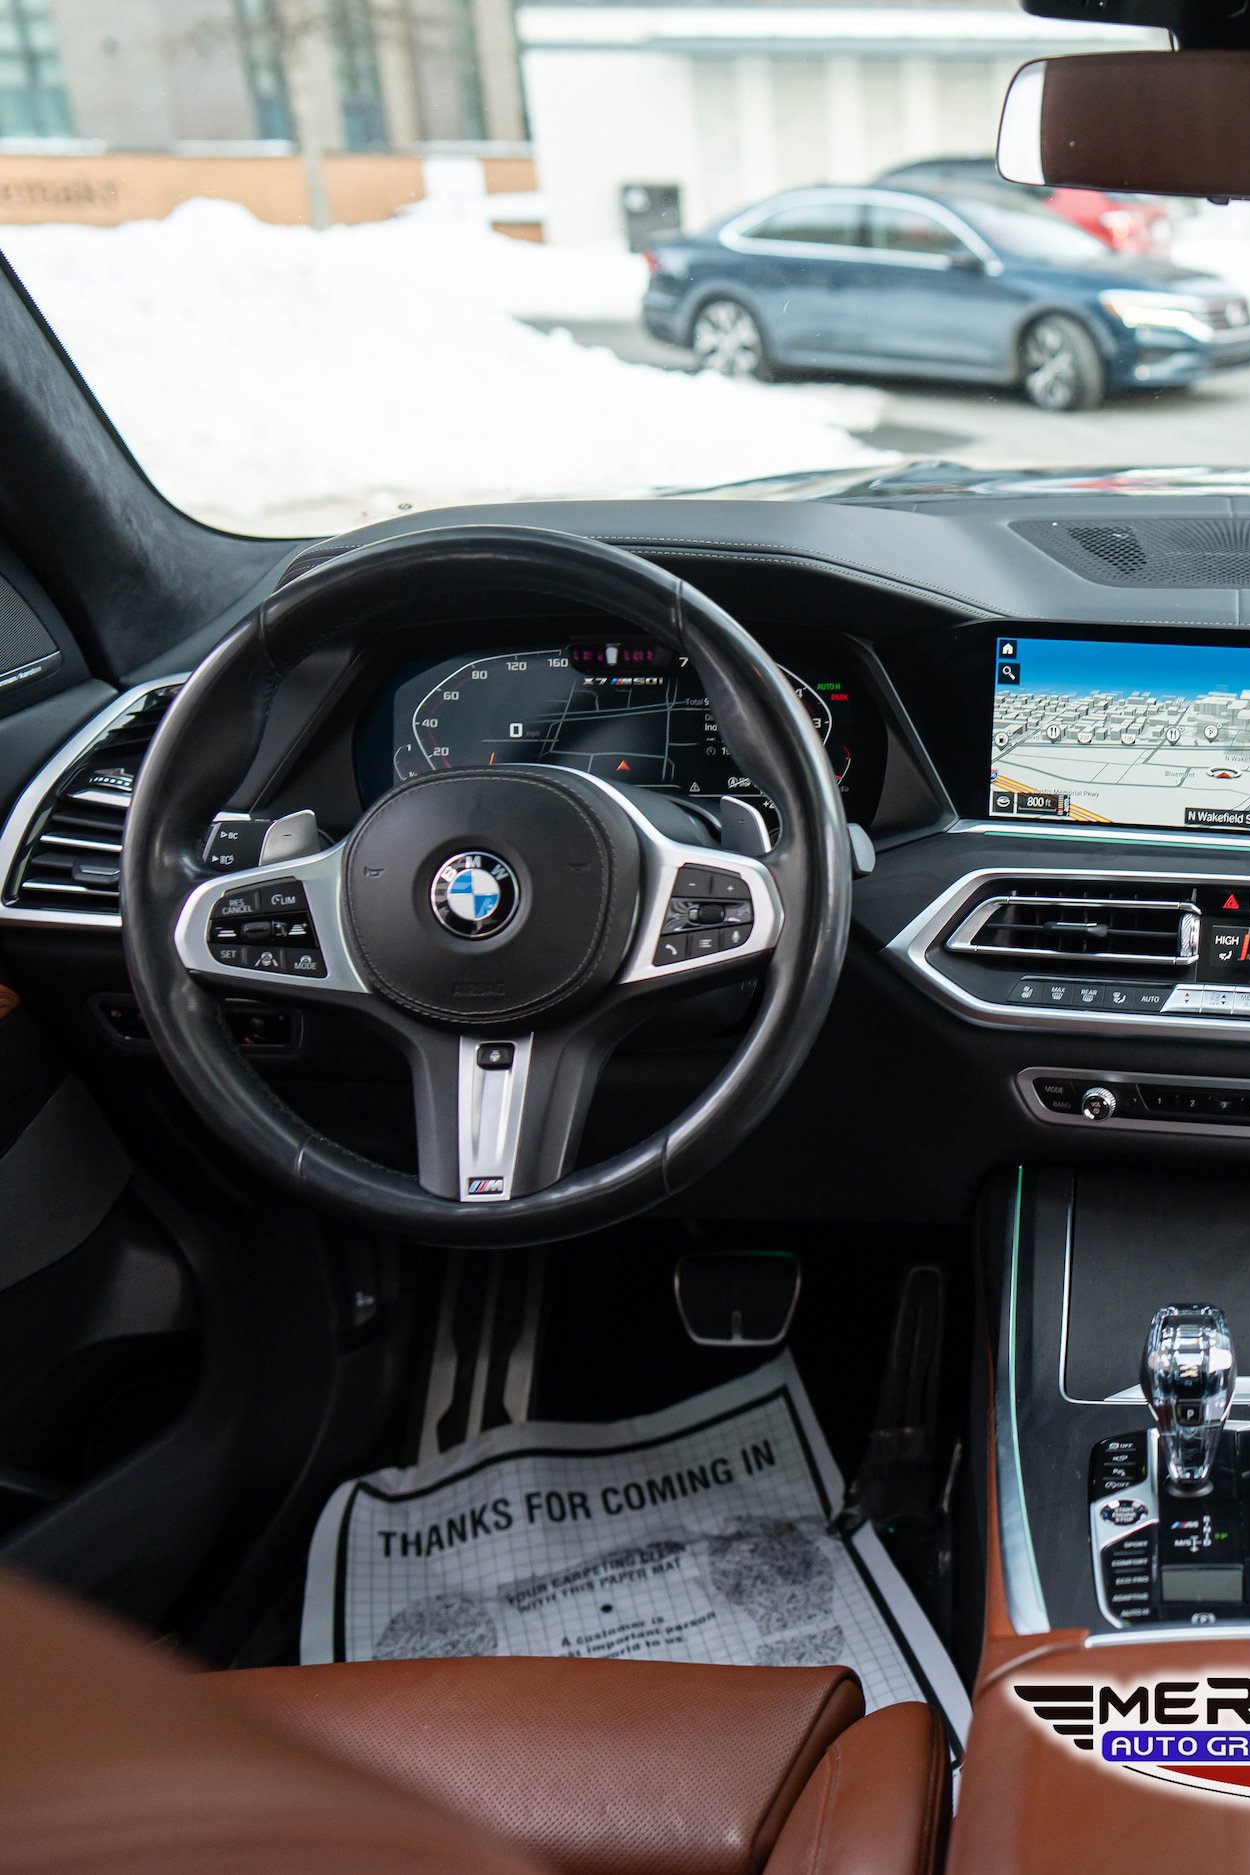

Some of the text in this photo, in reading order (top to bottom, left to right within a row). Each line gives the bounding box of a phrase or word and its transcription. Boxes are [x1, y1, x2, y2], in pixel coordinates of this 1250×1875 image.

[506, 661, 527, 672] 120
[549, 657, 569, 668] 160
[471, 670, 488, 680] 80
[582, 677, 608, 686] X7
[816, 683, 835, 691] AUTO
[443, 691, 460, 701] 60
[421, 719, 438, 729] 40
[509, 723, 523, 738] 0
[433, 747, 449, 757] 20
[1027, 796, 1051, 807] 800 ft
[1188, 812, 1197, 821] N
[1197, 812, 1244, 824] Wakefield
[441, 855, 509, 884] BMW
[229, 899, 244, 907] RES
[280, 895, 296, 906] LIM
[222, 904, 253, 915] CANCEL
[1214, 935, 1240, 946] HIGH
[220, 949, 237, 959] SET
[294, 961, 317, 970] MODE
[1051, 986, 1066, 994] MAX
[1080, 988, 1098, 997] REAR
[1140, 995, 1160, 1004] AUTO
[1187, 1408, 1195, 1419] P
[377, 1438, 777, 1558] THANKS FOR COMING IN
[1123, 1540, 1148, 1548] SPORT
[1111, 1557, 1148, 1567] COMFORT
[504, 1582, 548, 1606] YOUR
[551, 1553, 636, 1589] CARPETING
[516, 1557, 682, 1613] WITH THIS PAPER MAT
[665, 1611, 717, 1636] person
[561, 1615, 665, 1648] A customer is
